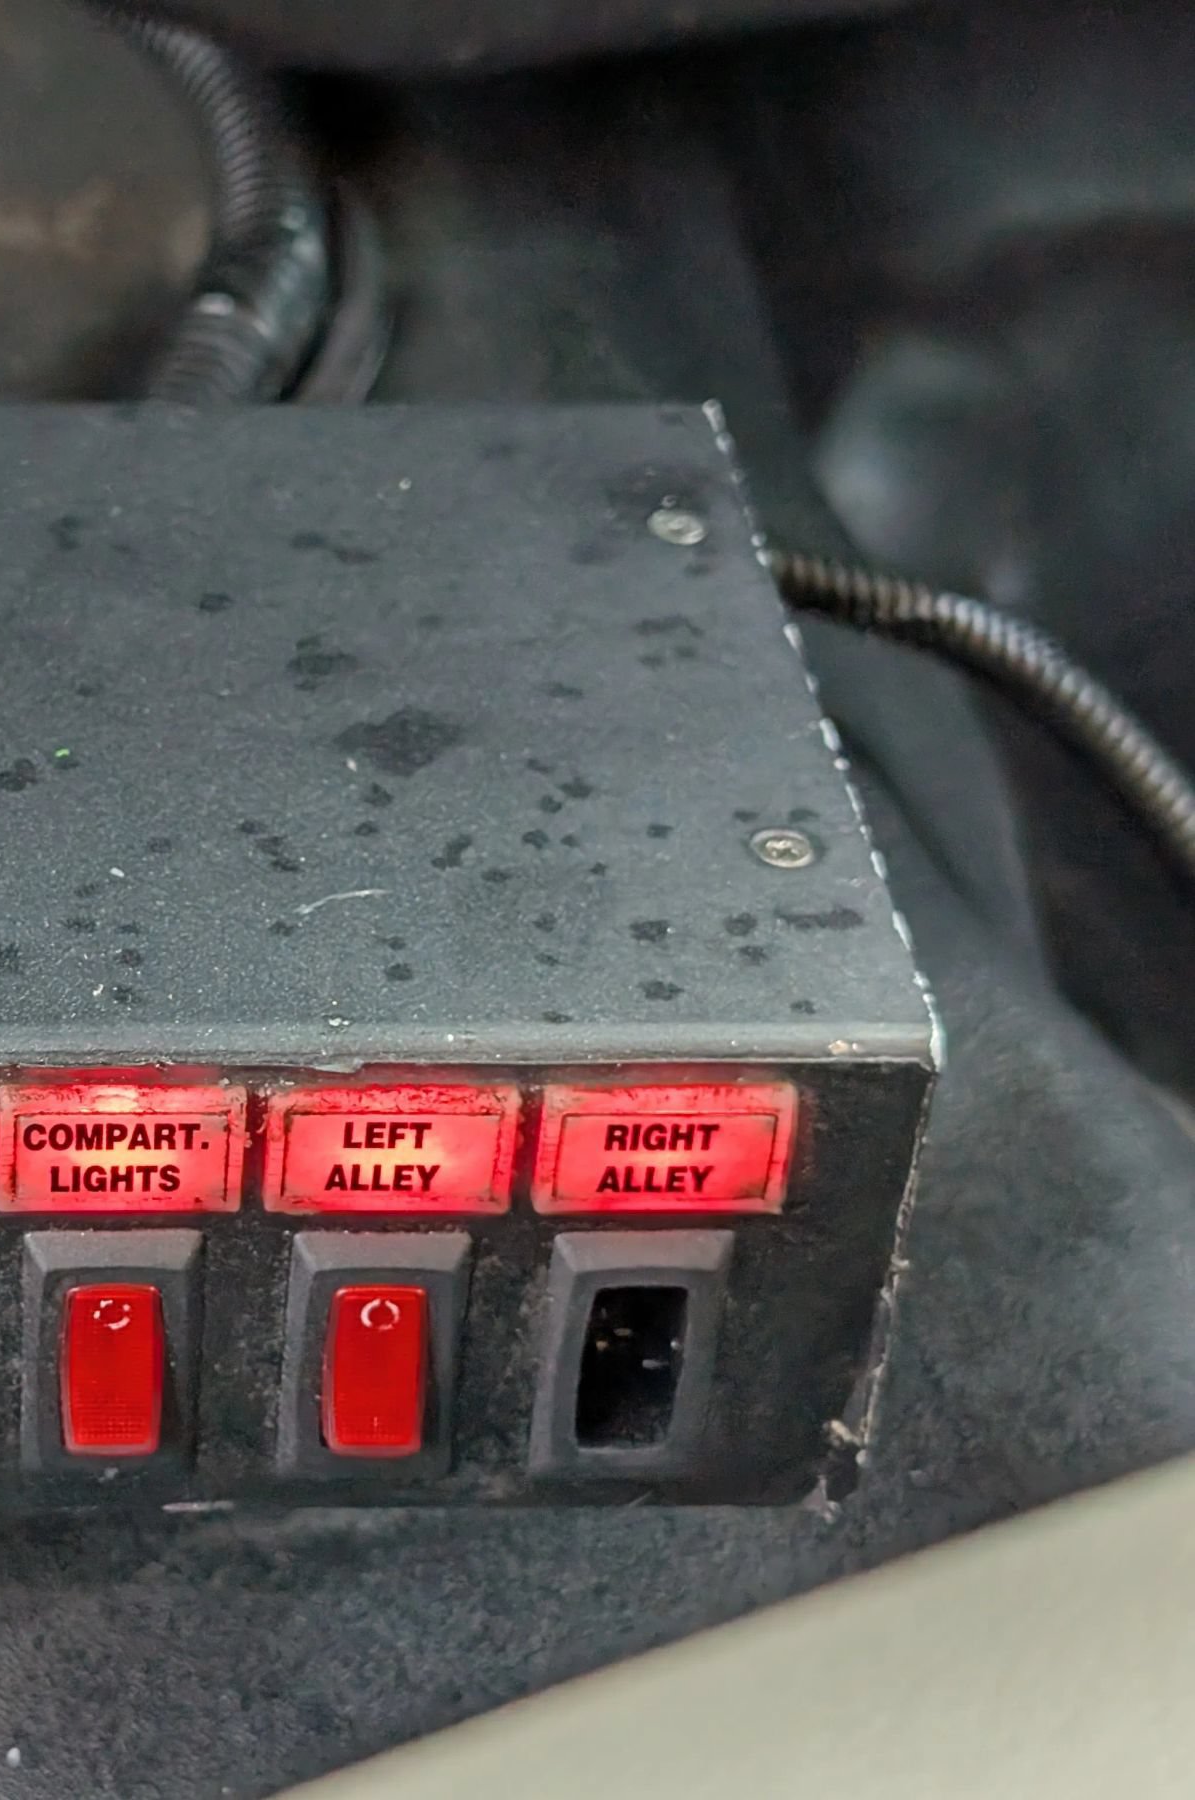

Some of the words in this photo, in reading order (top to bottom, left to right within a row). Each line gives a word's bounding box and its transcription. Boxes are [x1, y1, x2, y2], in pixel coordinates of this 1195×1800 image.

[23, 1123, 210, 1151] COMPART.
[343, 1122, 432, 1150] LEFT
[604, 1123, 719, 1151] RIGHT
[50, 1165, 181, 1193] LIGHTS
[324, 1164, 440, 1192] ALLEY
[596, 1166, 714, 1194] ALLEY
